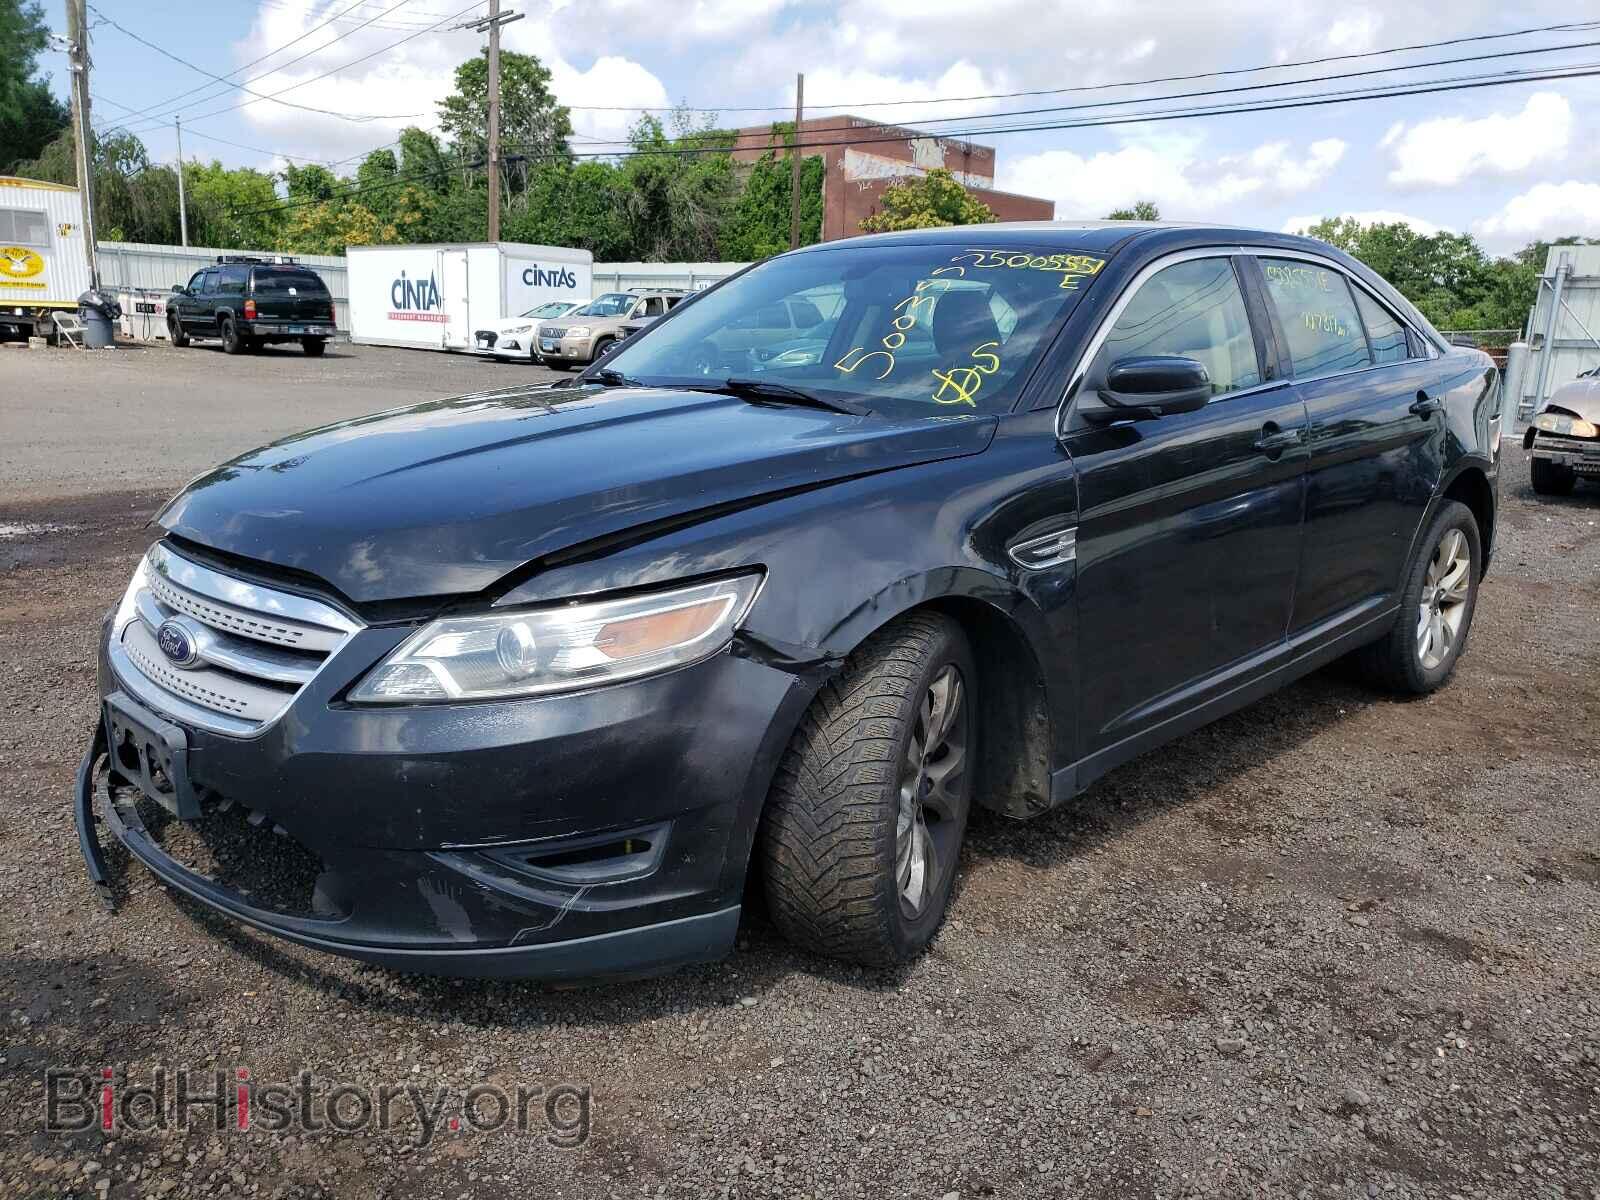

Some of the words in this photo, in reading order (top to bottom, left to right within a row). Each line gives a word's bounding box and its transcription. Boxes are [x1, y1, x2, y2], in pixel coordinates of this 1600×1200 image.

[391, 267, 442, 312] CINTA
[522, 263, 577, 289] CINTAS
[158, 630, 182, 657] Ford
